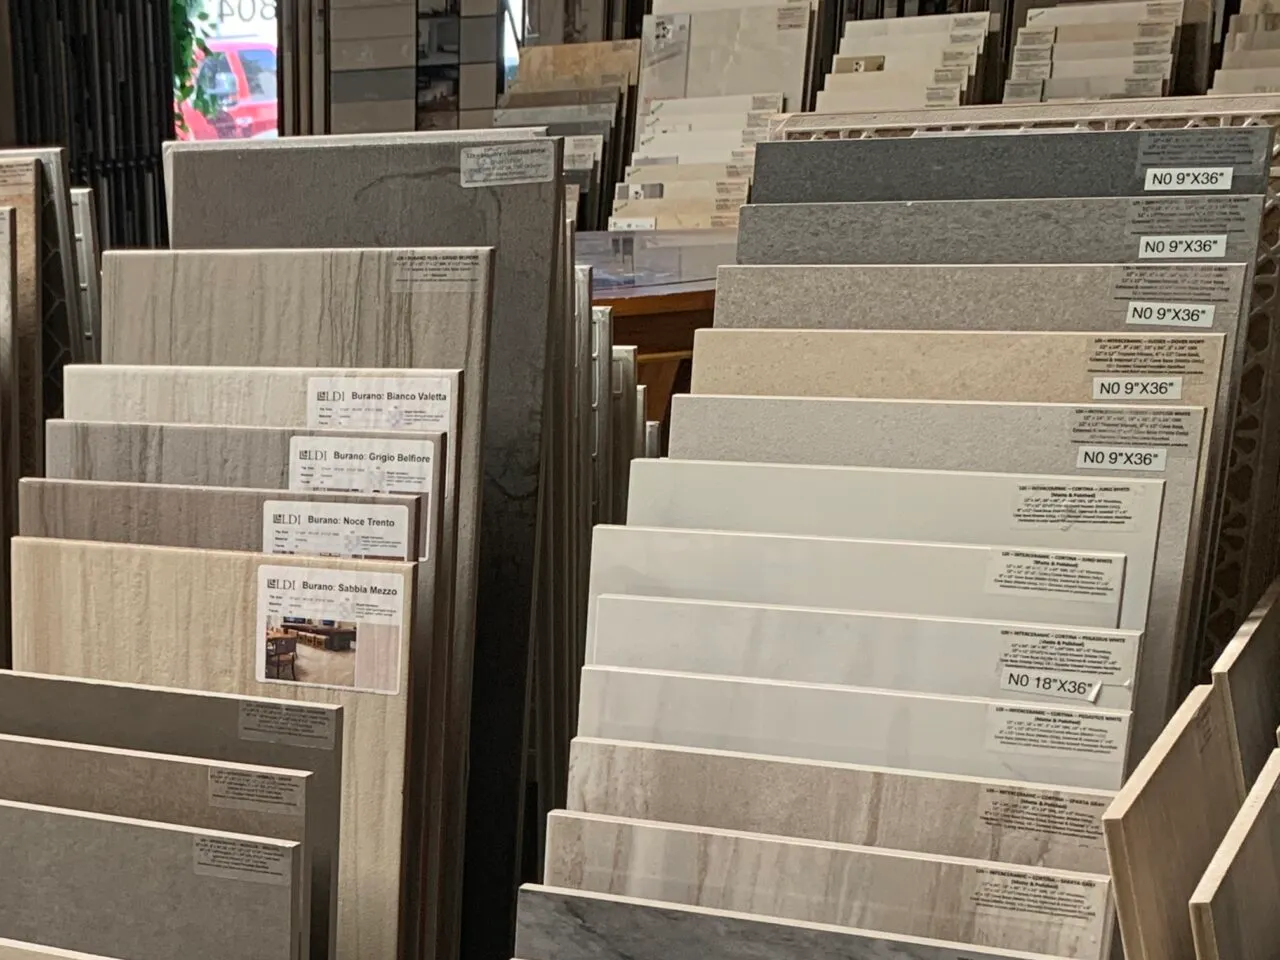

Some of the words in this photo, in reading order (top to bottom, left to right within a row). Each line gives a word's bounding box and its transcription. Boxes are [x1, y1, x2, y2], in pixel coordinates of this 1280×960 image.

[351, 391, 384, 401] Burano:
[387, 391, 416, 401] Bianco
[418, 392, 447, 401] Valetta
[369, 452, 395, 464] Grigio
[397, 453, 431, 463] Belfiore
[308, 515, 341, 525] Burano:
[343, 517, 365, 526] Noce
[367, 517, 395, 527] Trento
[338, 583, 367, 594] Sabbia
[370, 586, 398, 596] Mezzo
